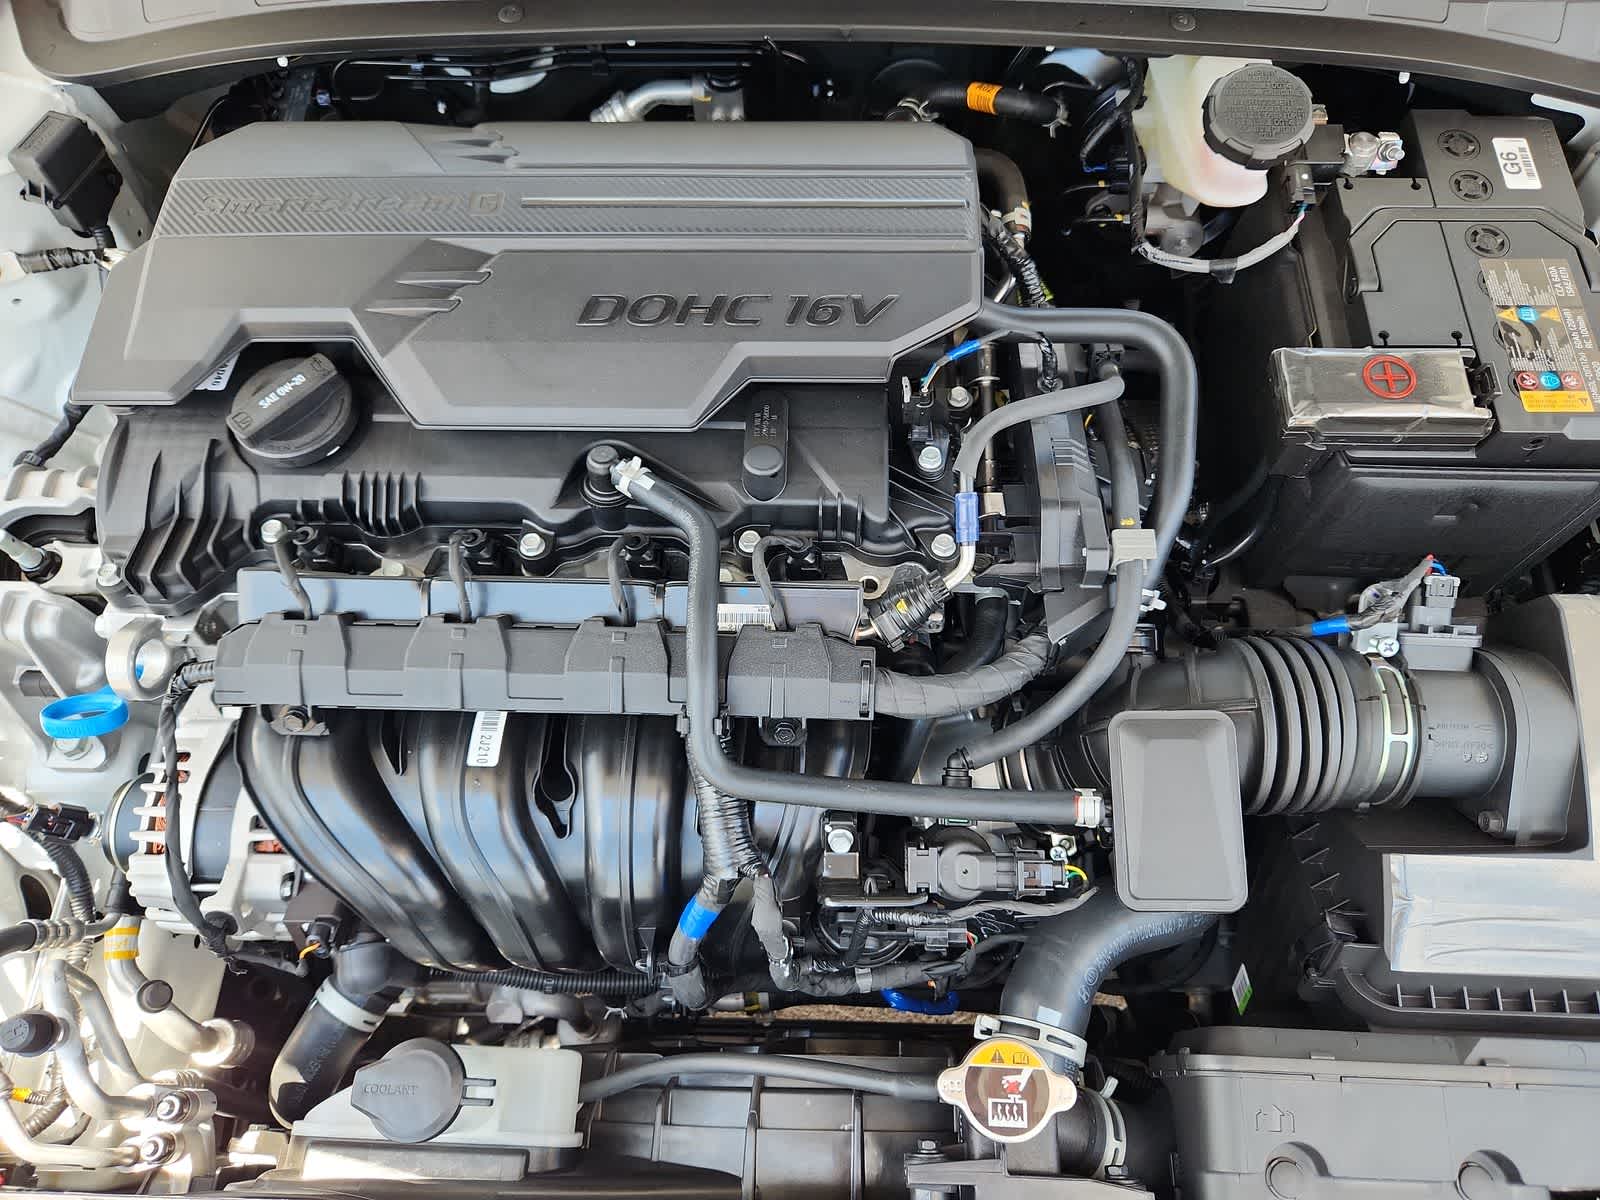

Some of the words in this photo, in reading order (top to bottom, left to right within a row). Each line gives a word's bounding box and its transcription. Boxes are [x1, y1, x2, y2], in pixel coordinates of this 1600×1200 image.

[1500, 152, 1522, 175] G6
[575, 293, 773, 327] DOHC
[785, 293, 900, 327] 16V
[258, 391, 280, 409] SAE
[363, 1083, 419, 1097] COOLANT
